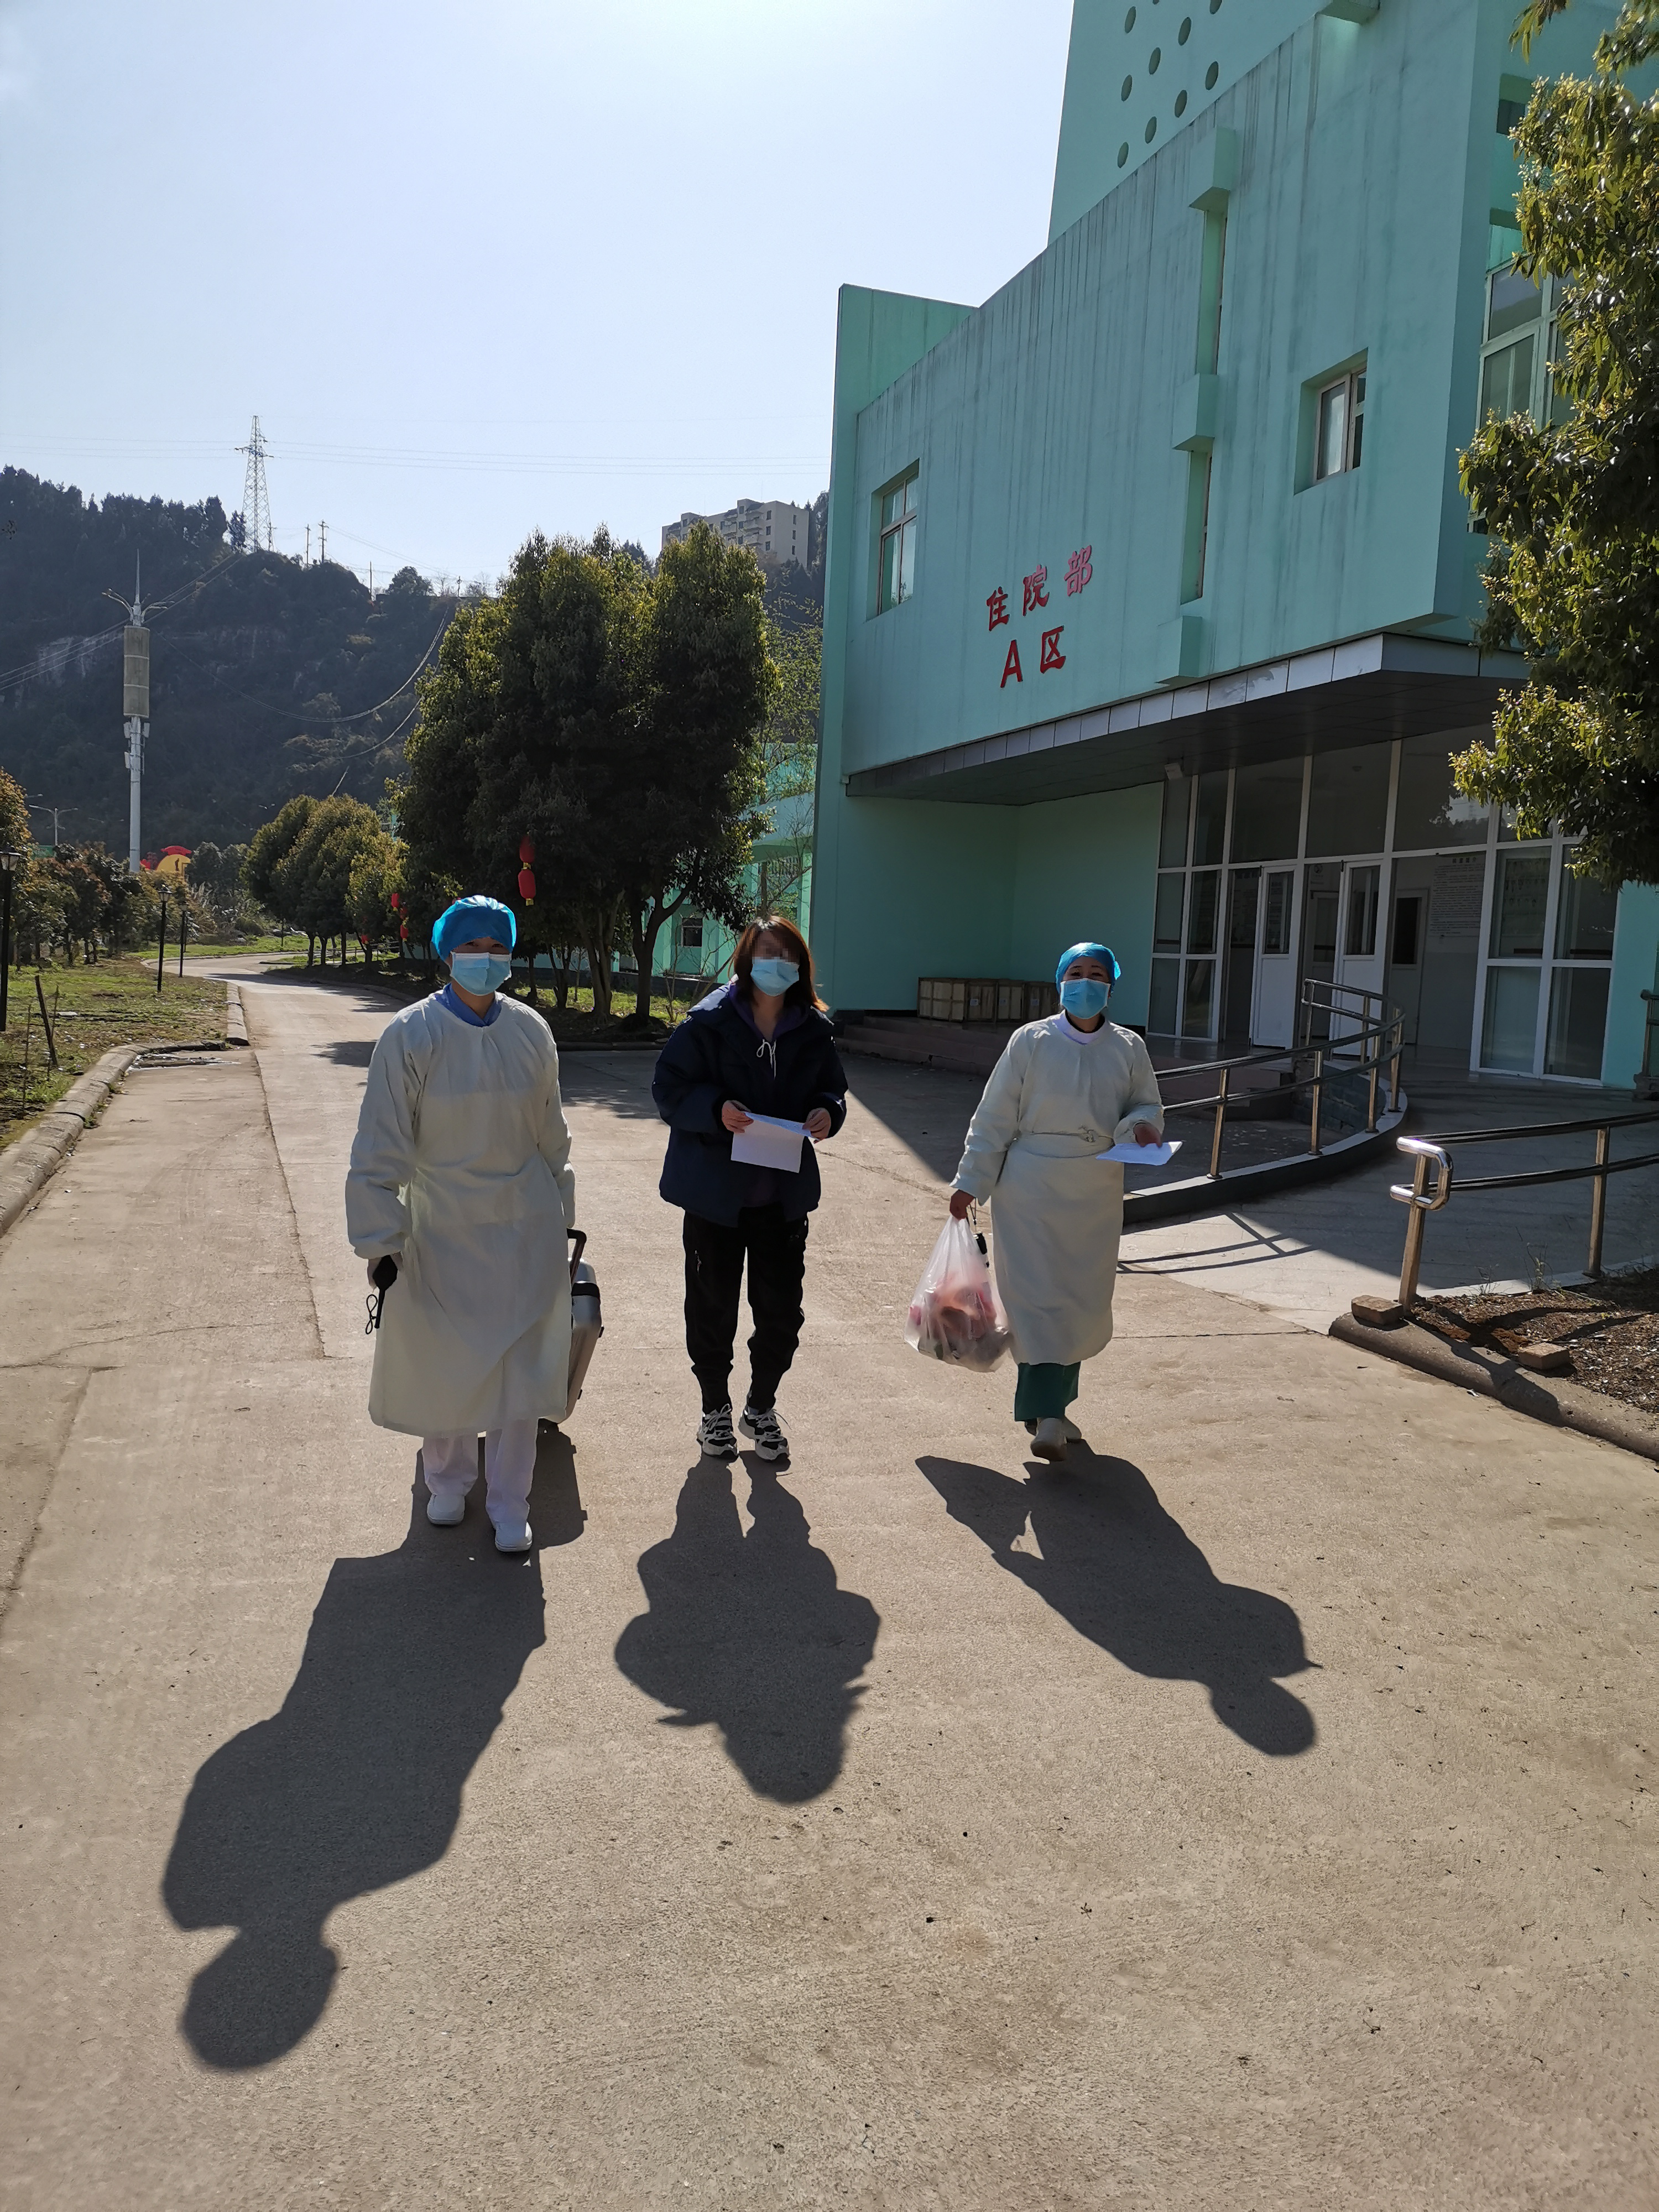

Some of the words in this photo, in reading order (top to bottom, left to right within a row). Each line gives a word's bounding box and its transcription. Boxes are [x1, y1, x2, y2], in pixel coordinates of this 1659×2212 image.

[987, 545, 1093, 631] 住院部
[1000, 625, 1066, 688] A区
